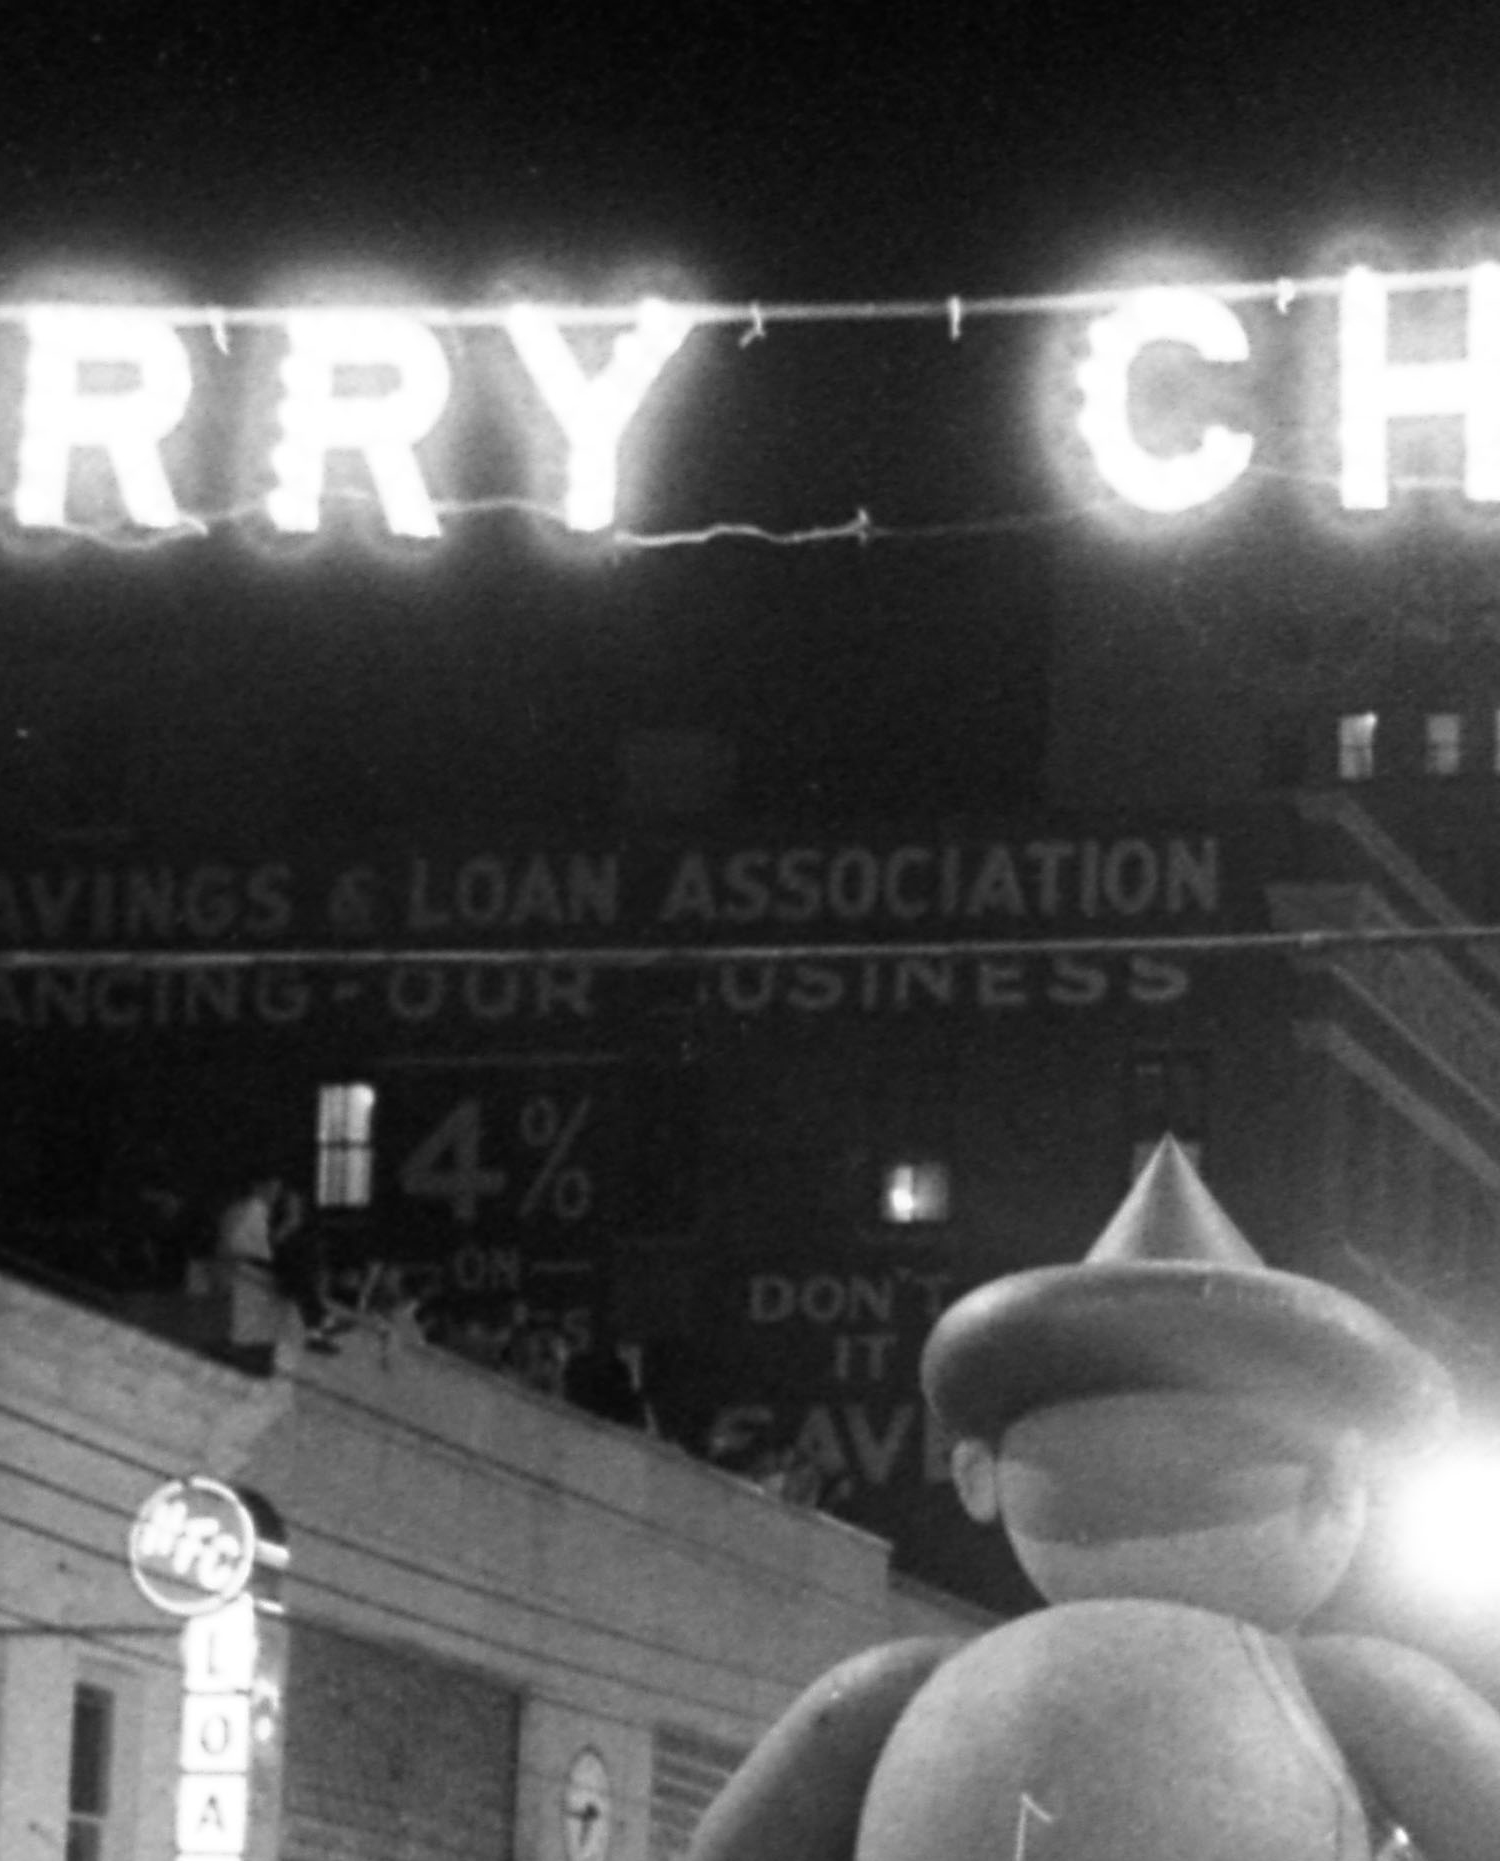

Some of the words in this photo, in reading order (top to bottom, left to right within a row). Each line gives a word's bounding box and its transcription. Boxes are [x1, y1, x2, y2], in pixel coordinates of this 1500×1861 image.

[327, 865, 380, 932] &
[407, 851, 620, 930] LOAN
[660, 836, 1222, 922] ASSOCIATION
[698, 952, 1192, 1013] USINESS
[398, 1095, 593, 1222] 4%
[834, 1334, 898, 1381] IT
